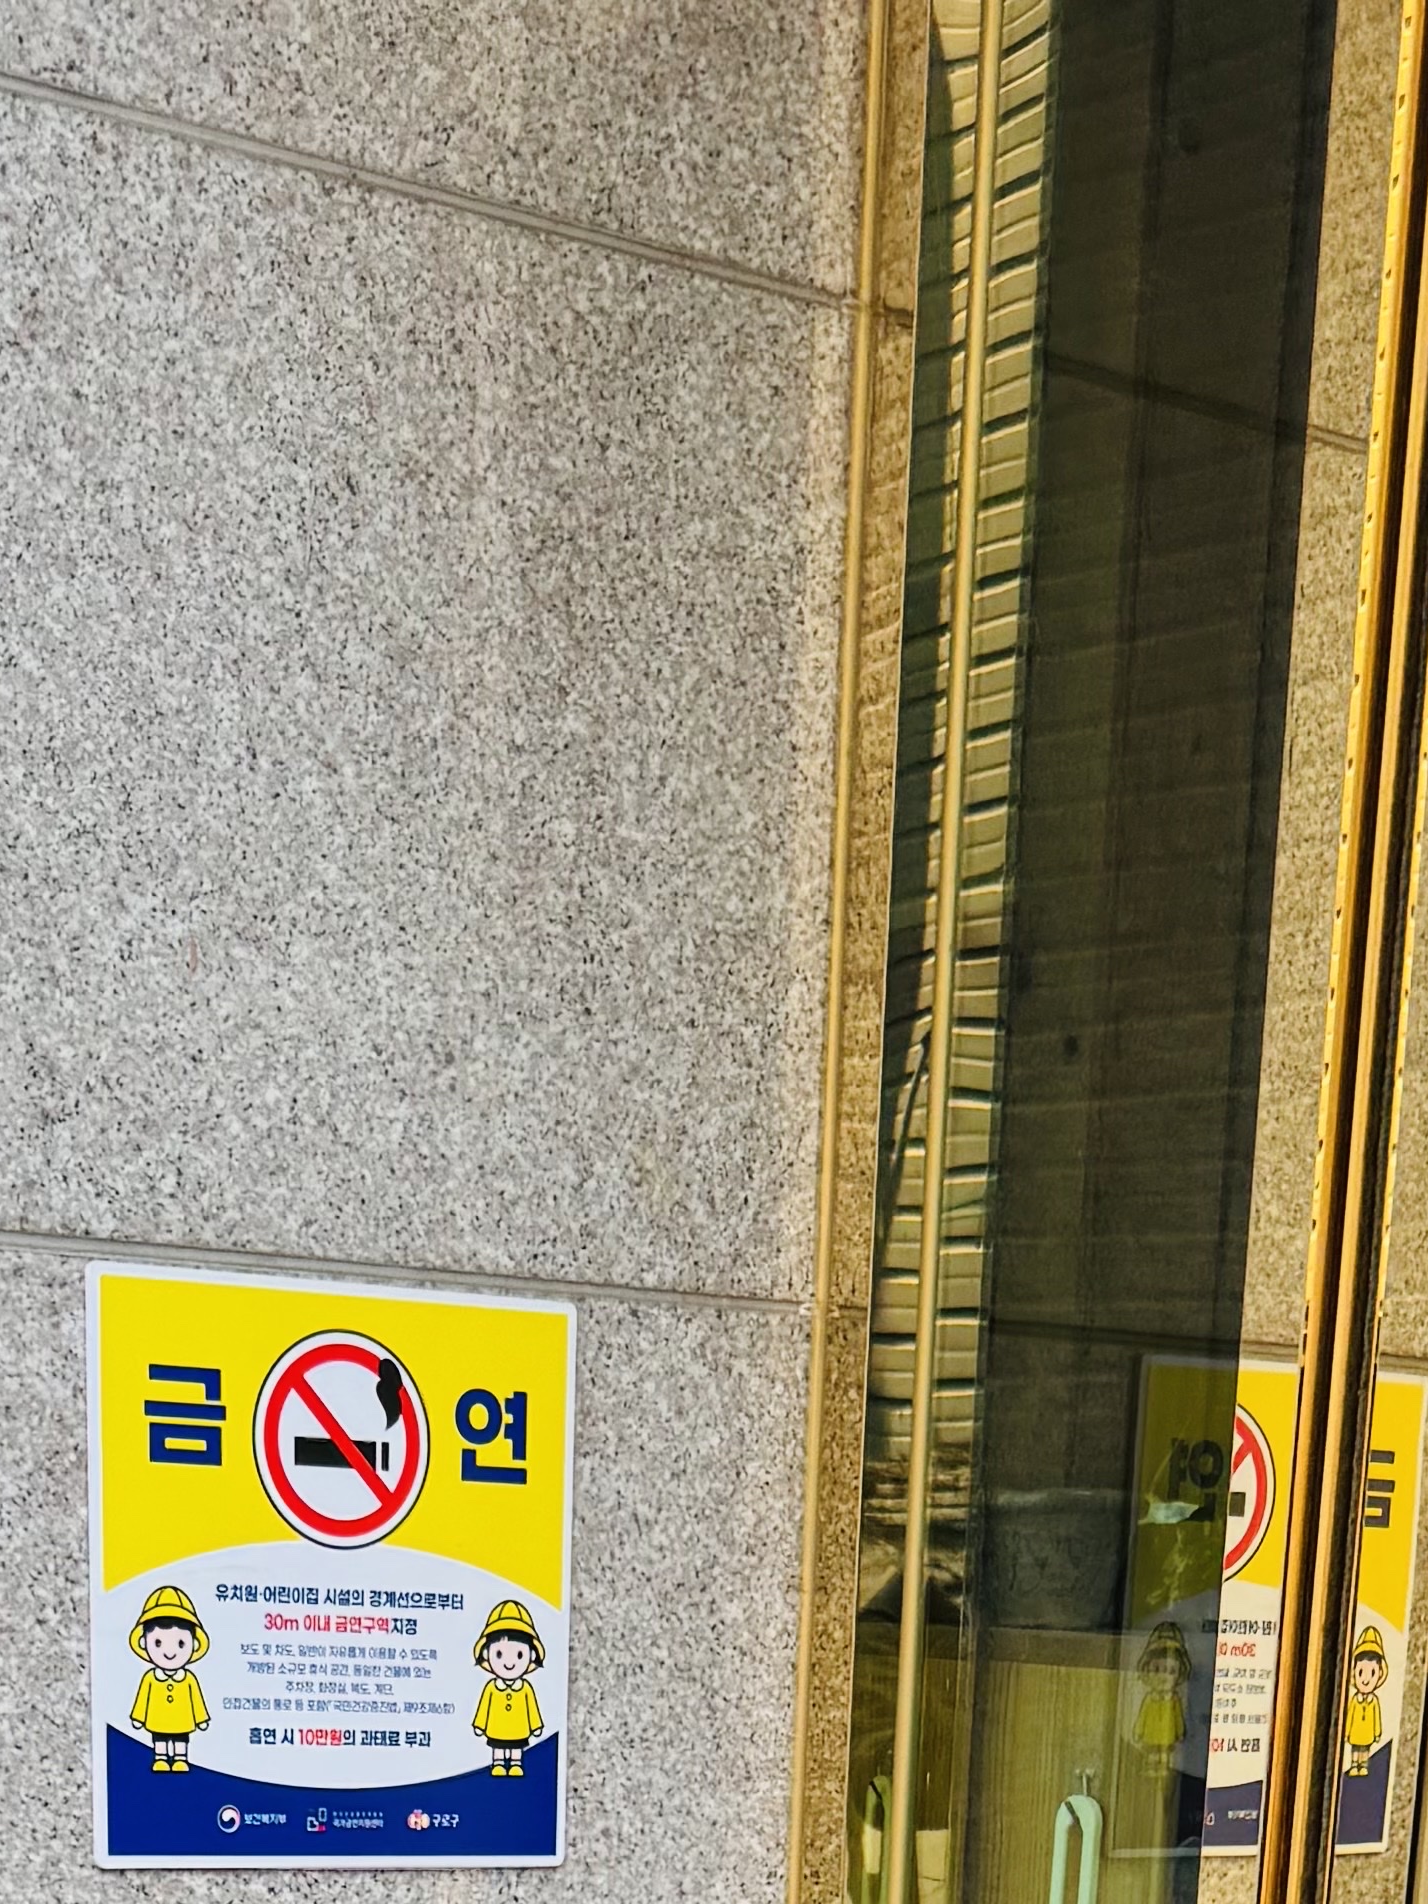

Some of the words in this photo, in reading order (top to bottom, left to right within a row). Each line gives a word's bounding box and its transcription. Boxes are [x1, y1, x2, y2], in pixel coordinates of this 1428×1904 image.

[143, 1363, 227, 1467] 금
[453, 1388, 529, 1485] 연
[324, 1588, 365, 1607] 시설의
[369, 1589, 465, 1611] 경계선으로부터
[264, 1613, 299, 1632] 30m
[304, 1614, 331, 1632] 이내
[335, 1615, 418, 1636] 금연구역지정
[240, 1643, 260, 1655] 보도
[277, 1662, 306, 1675] 소규모
[248, 1727, 277, 1745] 흡연
[281, 1728, 294, 1745] 시
[298, 1728, 356, 1746] 10만원의
[360, 1729, 401, 1747] 과태료
[404, 1730, 432, 1748] 부과
